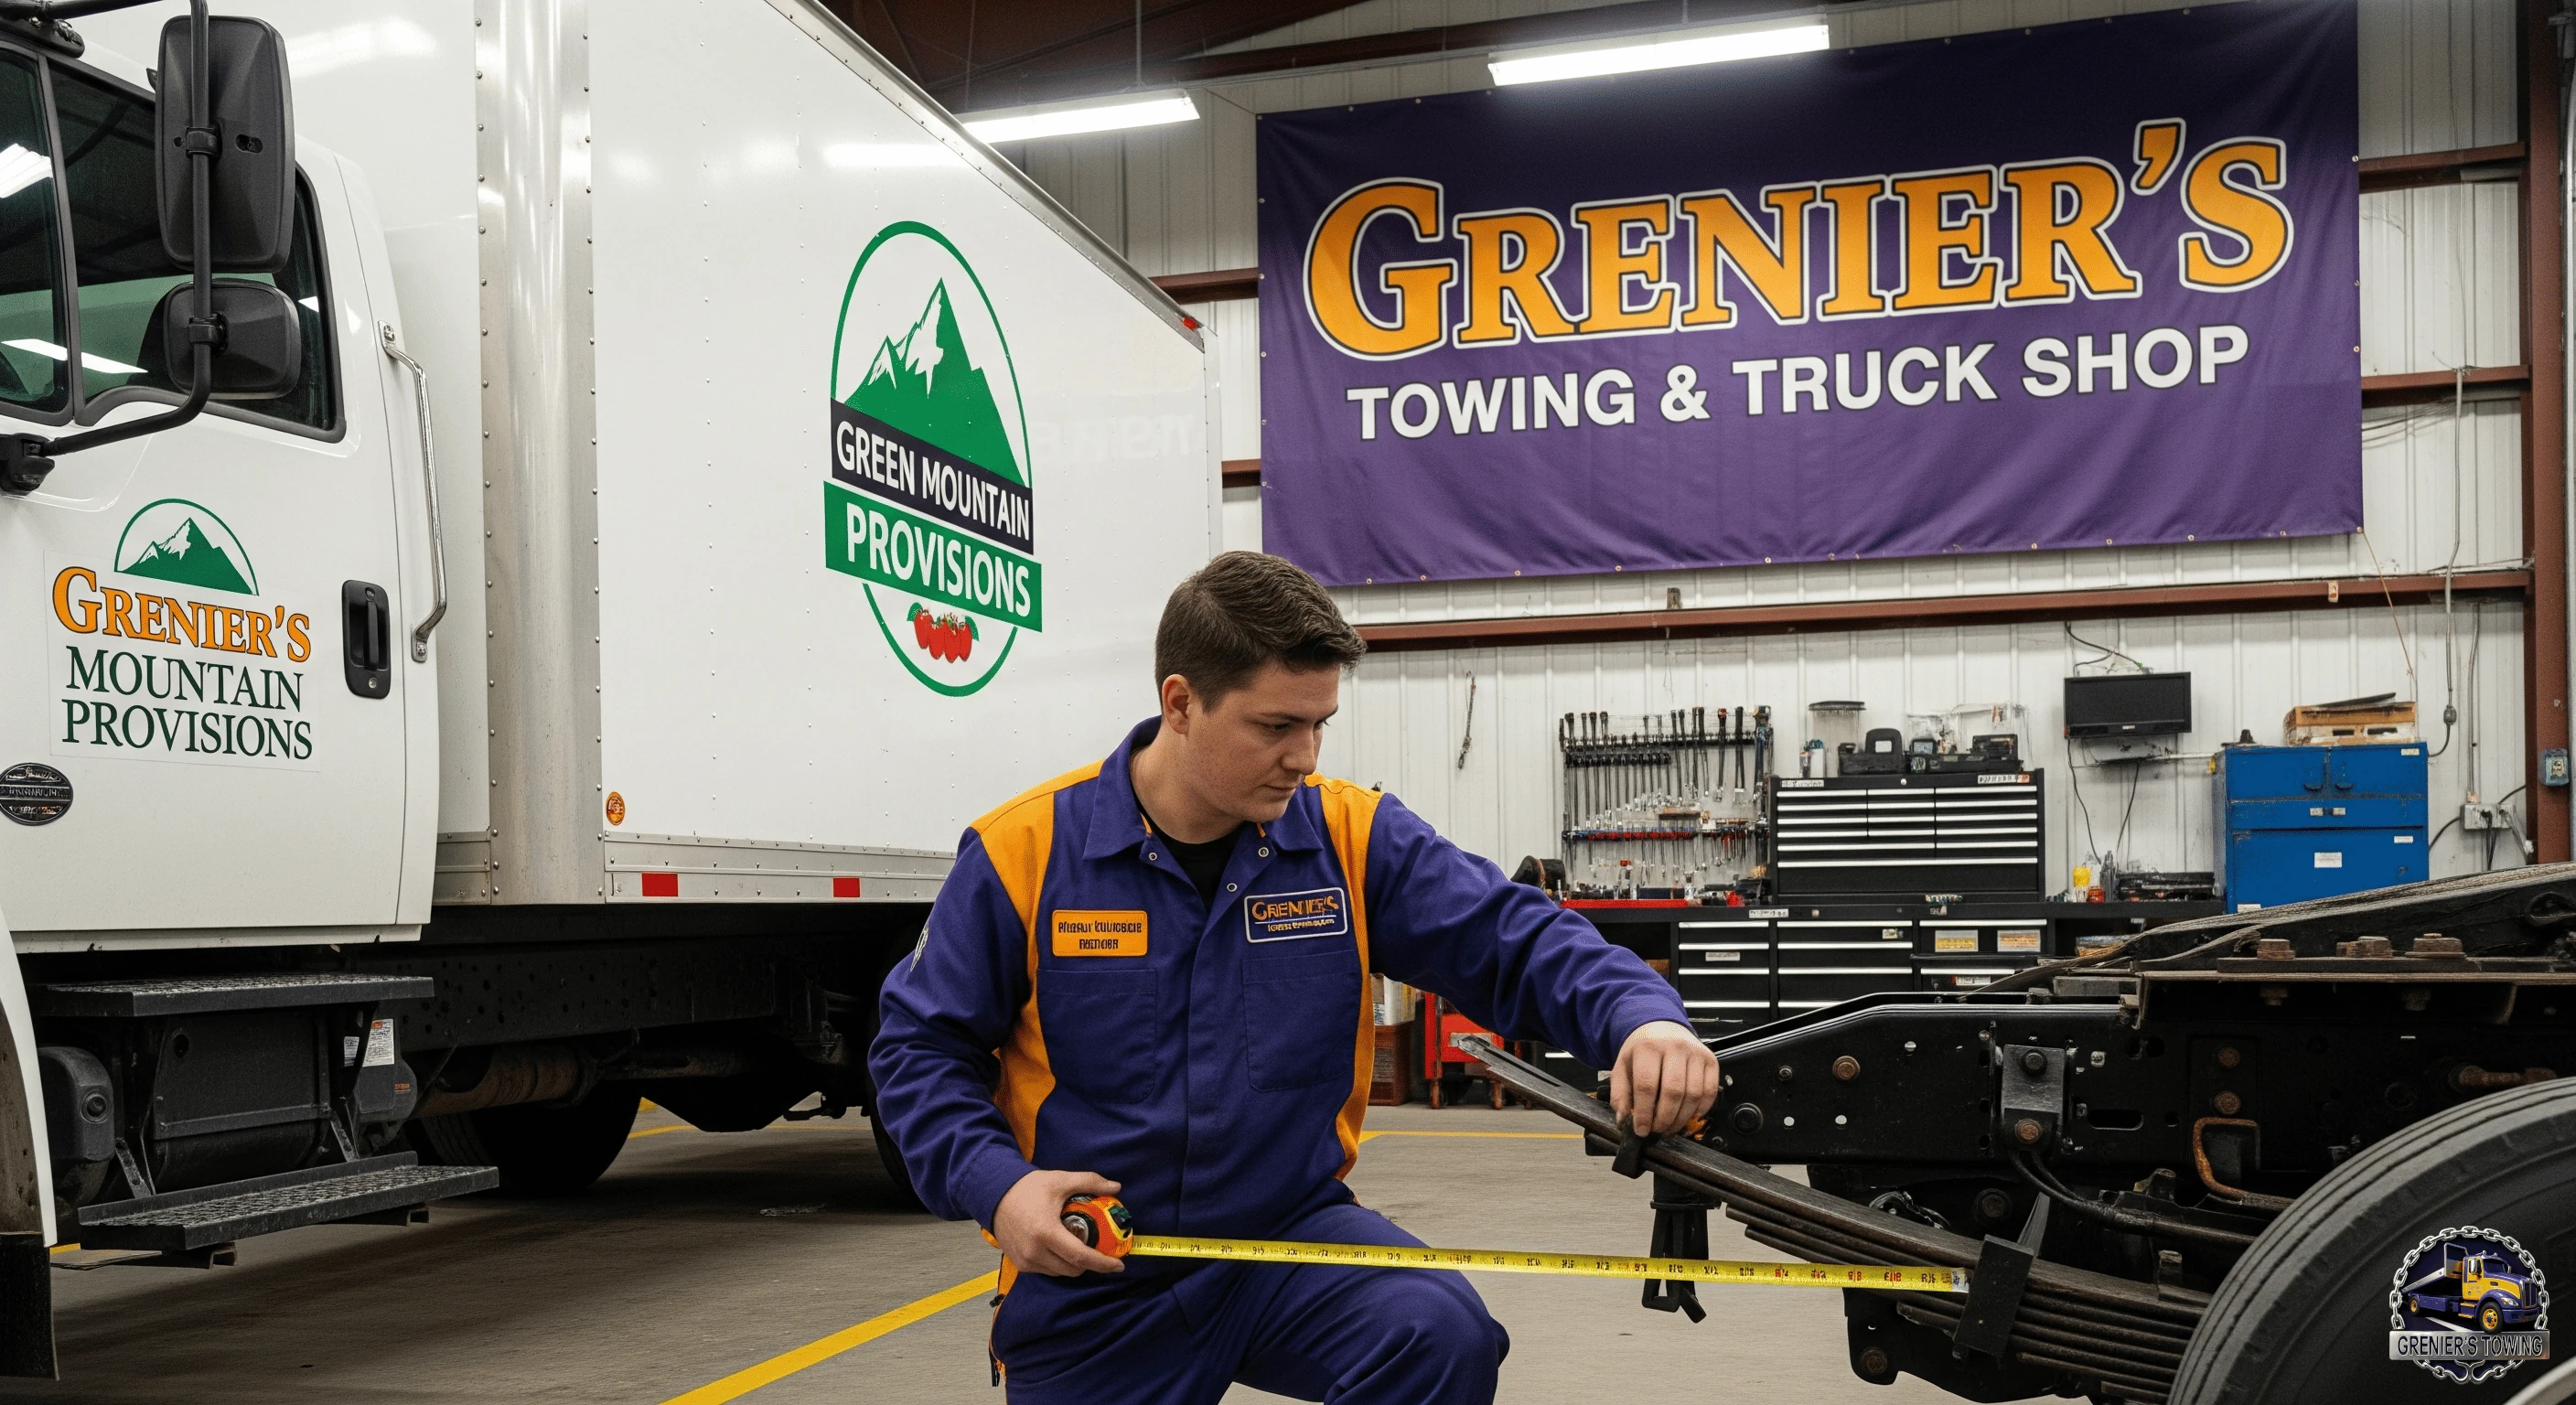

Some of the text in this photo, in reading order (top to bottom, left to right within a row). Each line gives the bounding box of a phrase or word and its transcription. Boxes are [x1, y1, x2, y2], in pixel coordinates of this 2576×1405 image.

[1304, 117, 2294, 360] GRENIER'S
[1347, 325, 2249, 440] TOWING & TRUCK SHOP
[836, 421, 1030, 541] GREEN MOUNTAIN
[52, 566, 312, 663] GRENIER'S
[846, 502, 1031, 617] PROVISIONS
[61, 699, 313, 760] PROVISIONS
[66, 646, 304, 712] MOUNTAIN
